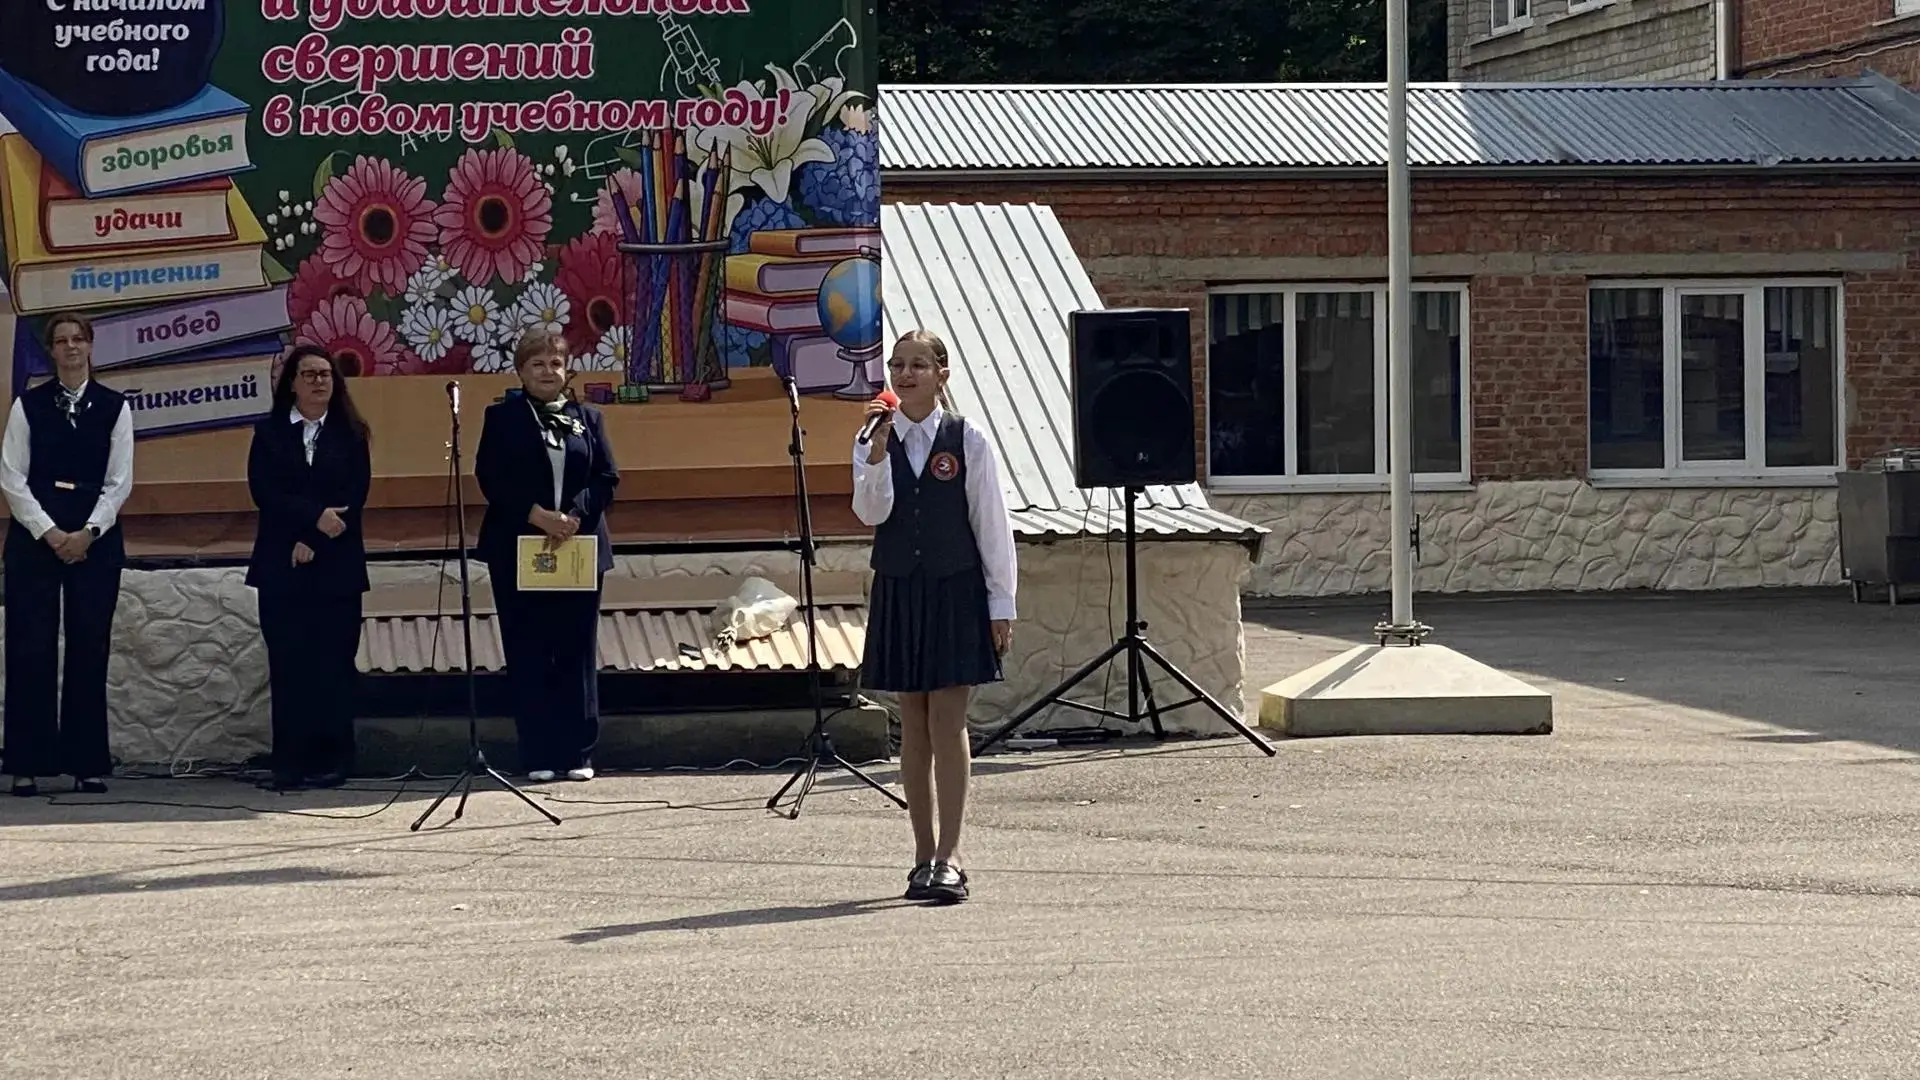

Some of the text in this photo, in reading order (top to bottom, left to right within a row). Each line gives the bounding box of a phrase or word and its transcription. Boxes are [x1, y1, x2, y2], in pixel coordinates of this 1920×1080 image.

[55, 18, 190, 48] учебного
[86, 48, 160, 72] года!
[262, 28, 594, 94] свершений
[263, 88, 792, 142] в новом учебном году!
[102, 134, 233, 172] здоровья
[95, 208, 182, 237] удачи
[70, 263, 220, 293] терпения
[136, 310, 221, 343] побед
[122, 374, 258, 411] тижений
